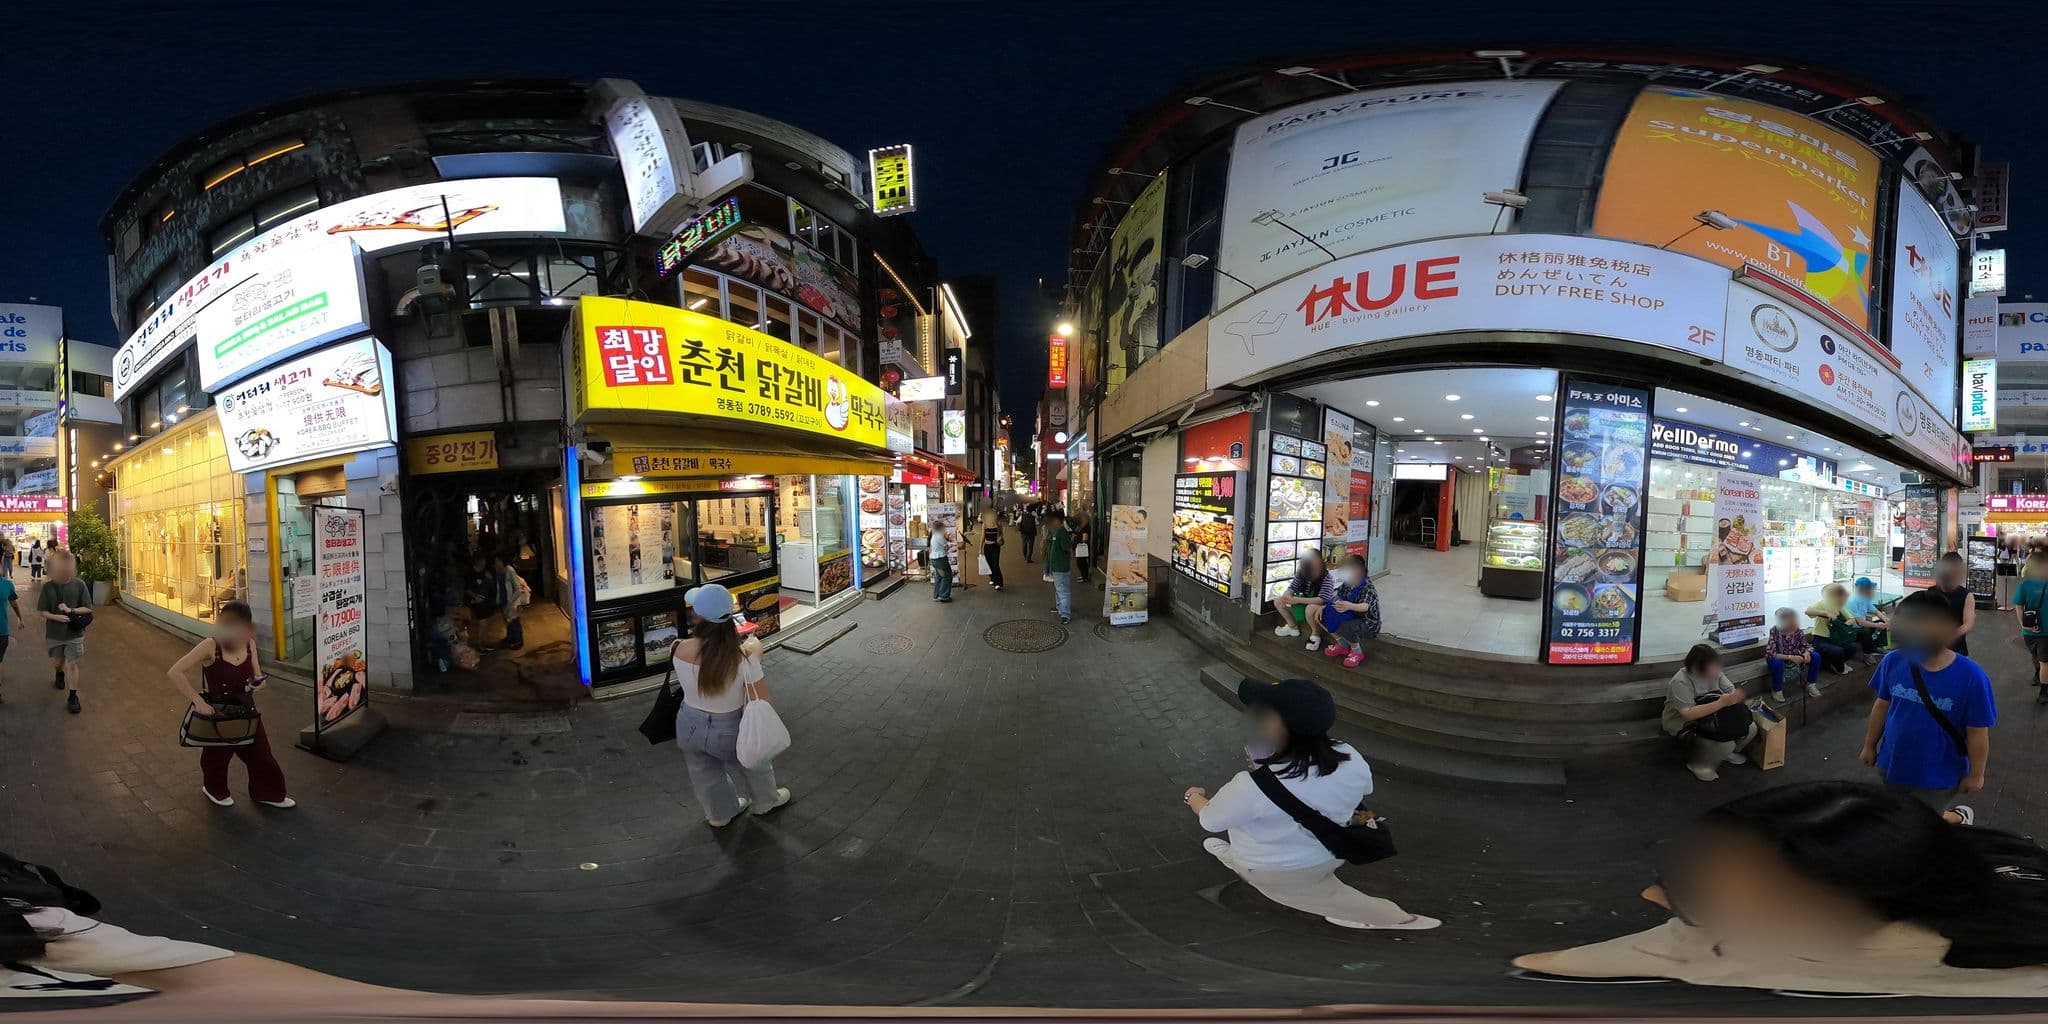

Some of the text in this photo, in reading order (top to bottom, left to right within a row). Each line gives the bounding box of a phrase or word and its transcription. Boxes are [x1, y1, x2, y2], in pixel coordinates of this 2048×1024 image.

[1648, 120, 1869, 208] Supermarket
[1275, 230, 1329, 255] JAYJUN
[1334, 207, 1416, 233] COSMETIC
[1498, 251, 1652, 277] 休格丽雅免税店
[1766, 242, 1792, 268] B1
[1497, 268, 1628, 288] めんぜいてん
[1978, 255, 1994, 279] 아미소
[177, 261, 230, 307] 생고기
[1495, 284, 1665, 310] DUTY FREE SHOP
[1342, 311, 1381, 325] buying
[1384, 303, 1429, 318] gallery
[4, 327, 27, 337] de
[603, 329, 663, 355] 최강
[725, 330, 754, 347] 닭갈비
[1687, 325, 1716, 346] 2F
[608, 355, 668, 384] 달인
[236, 367, 312, 405] 엉터리 생고기
[679, 339, 746, 393] 춘천
[757, 359, 822, 412] 닭갈비
[850, 394, 885, 432] 막국수
[1971, 372, 1988, 416] baviphat
[717, 398, 743, 412] 명동점
[748, 403, 794, 421] 3789.5592
[1606, 393, 1643, 408] 아미소
[304, 406, 347, 427] 提供无限
[1651, 423, 1738, 454] WellDerma
[425, 440, 494, 464] 중앙전기
[651, 457, 733, 471] 춘천 닭갈비 막국수
[1721, 486, 1744, 497] Korean
[7, 499, 38, 508] MART
[322, 560, 360, 578] 无限提供
[1726, 581, 1754, 595] 삼겹살
[323, 630, 348, 646] KOREAN
[1561, 628, 1620, 637] 02 756 3317
[331, 637, 353, 652] BUFFET
